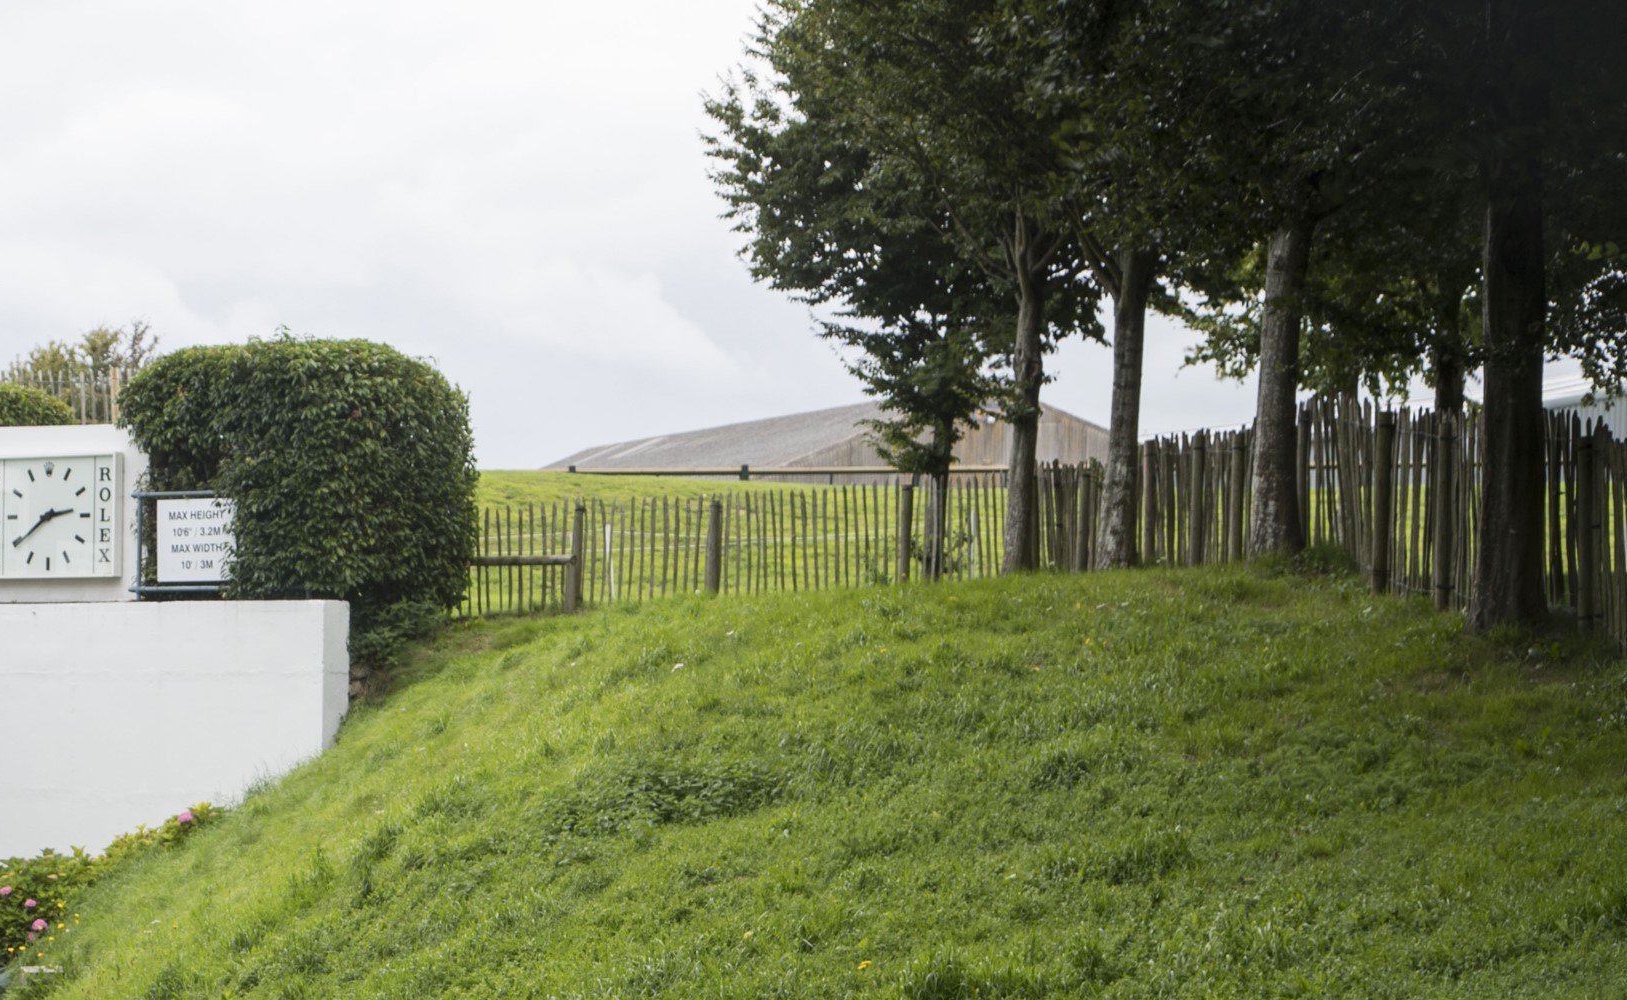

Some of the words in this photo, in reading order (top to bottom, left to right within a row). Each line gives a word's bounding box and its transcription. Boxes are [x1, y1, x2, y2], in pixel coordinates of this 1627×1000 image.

[98, 466, 112, 564] ROLEX
[168, 511, 188, 521] MAX
[190, 510, 224, 520] HEIGHT
[199, 526, 221, 536] 3.2M
[171, 544, 191, 553] MAX
[192, 543, 223, 553] WIDTH
[200, 559, 214, 569] 3M
